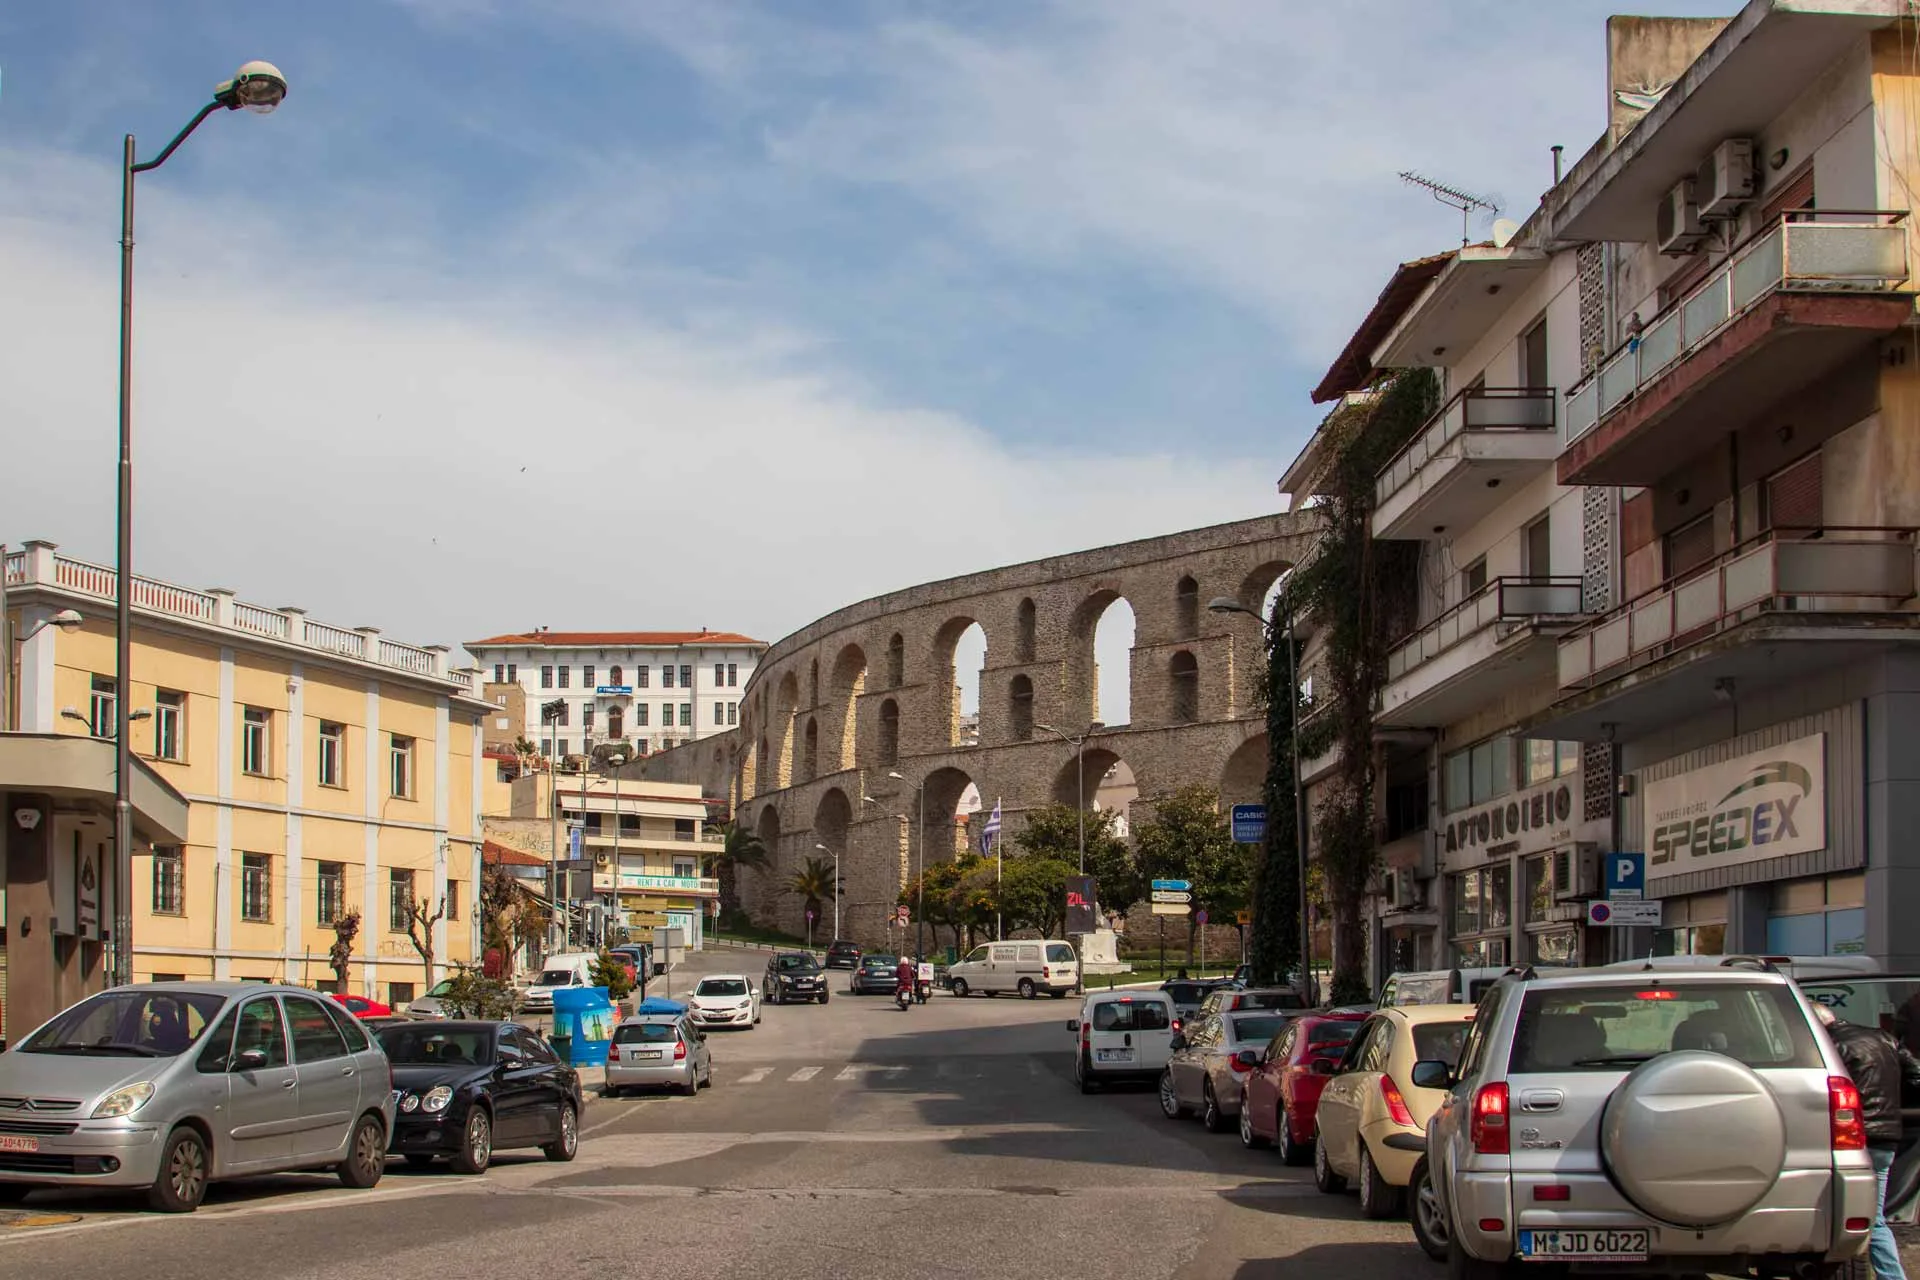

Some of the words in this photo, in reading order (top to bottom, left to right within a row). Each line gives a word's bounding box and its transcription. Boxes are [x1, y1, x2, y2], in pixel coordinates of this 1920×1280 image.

[1445, 785, 1571, 853] ΑΡΤΟΠΟΙΕΙΟ
[1651, 794, 1802, 866] SPEEDEX
[1617, 859, 1635, 882] P
[637, 878, 653, 887] RENT
[663, 879, 676, 888] CAR
[681, 879, 698, 889] MOTO
[1533, 1232, 1548, 1252] M
[1562, 1233, 1588, 1252] JD
[1593, 1233, 1645, 1252] 6022
